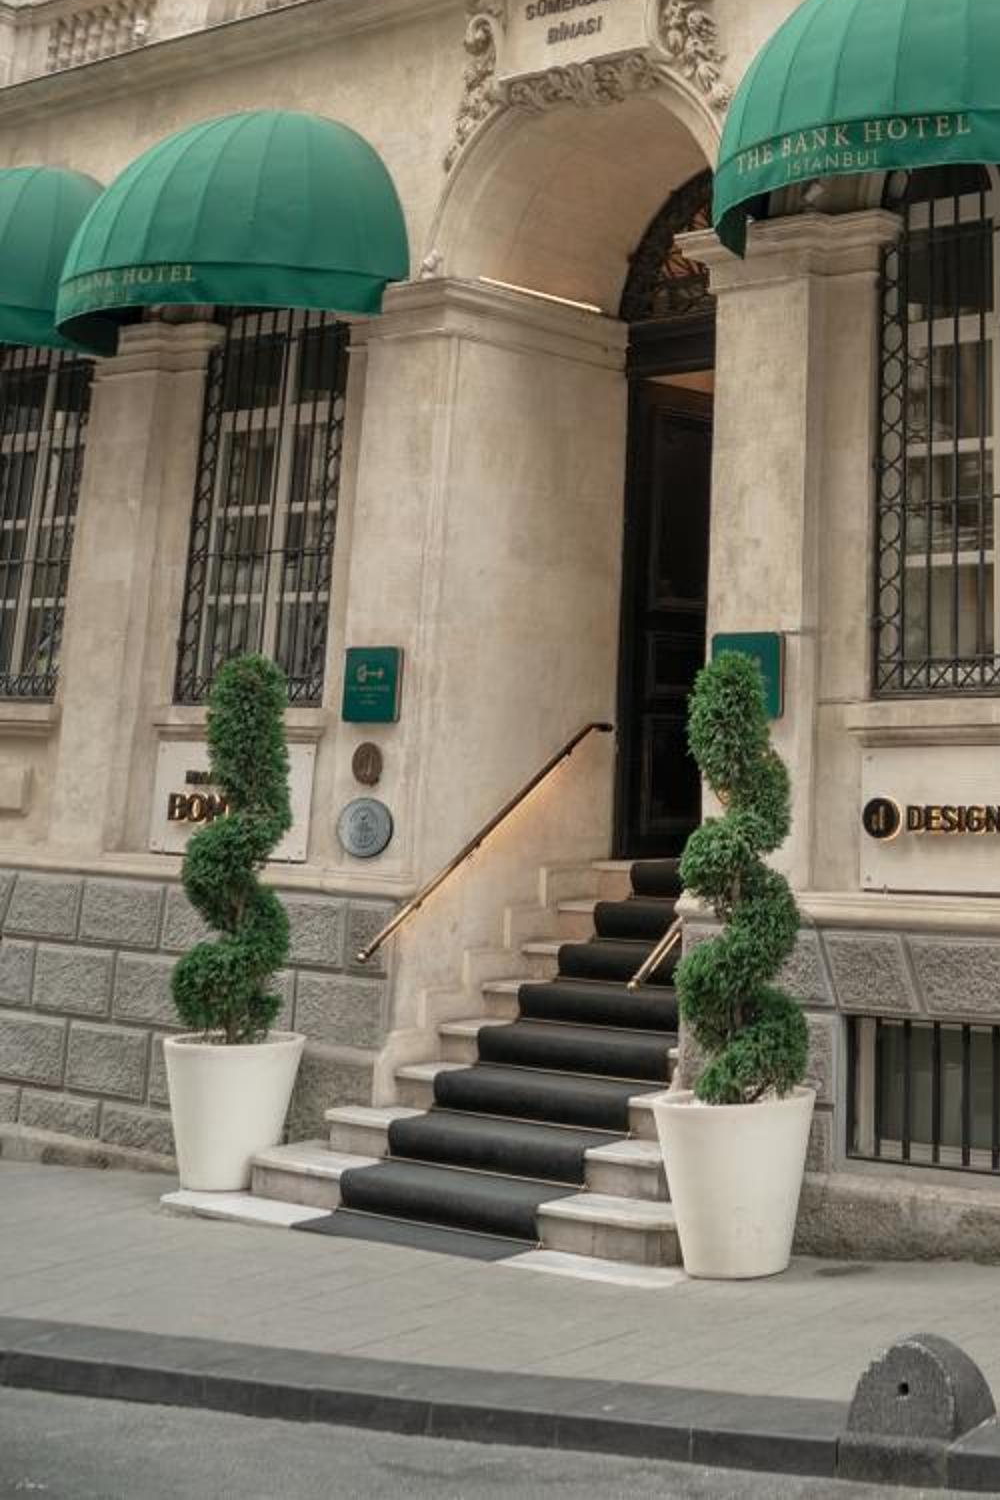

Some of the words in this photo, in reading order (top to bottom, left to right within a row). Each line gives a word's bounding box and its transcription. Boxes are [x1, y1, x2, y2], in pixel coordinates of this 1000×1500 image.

[736, 145, 774, 175] THE
[781, 124, 850, 157] BANK
[863, 113, 972, 143] HOTEL
[123, 264, 195, 285] HOTEL
